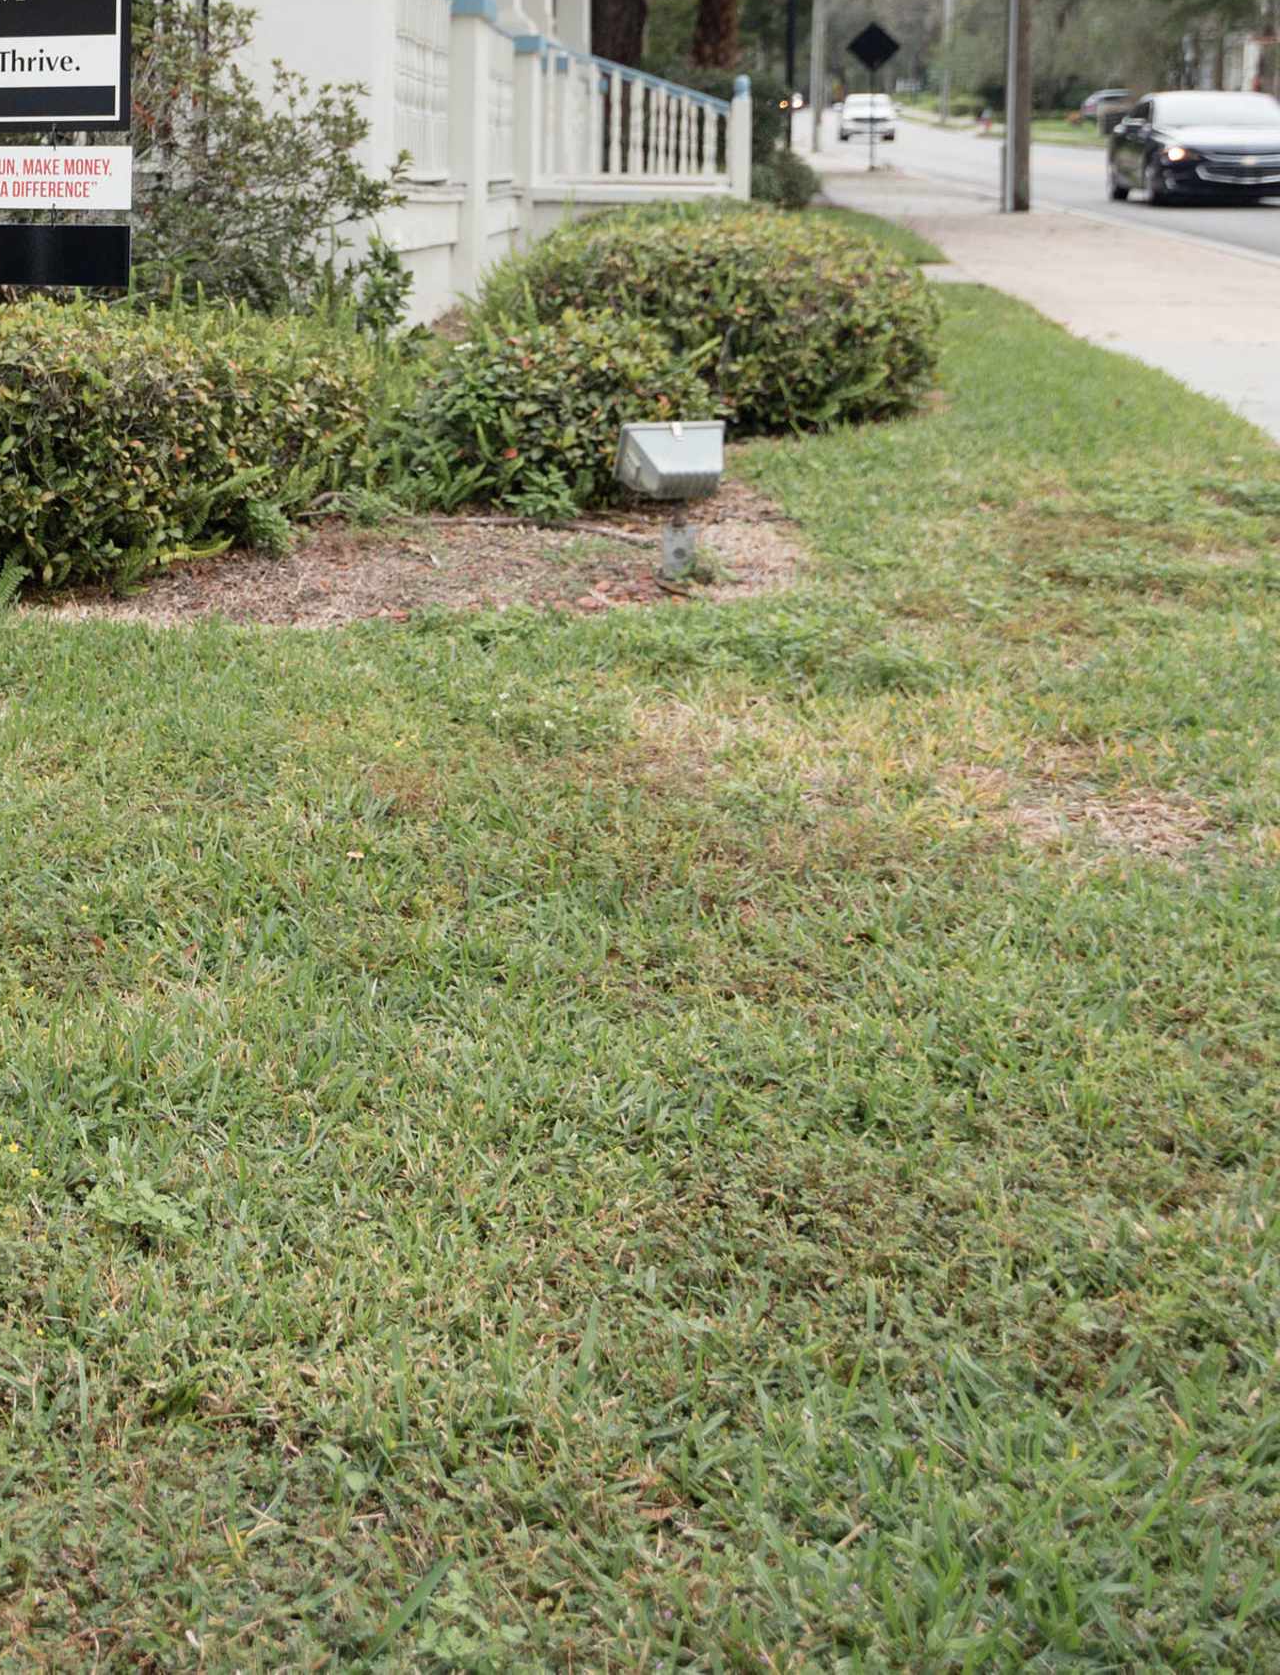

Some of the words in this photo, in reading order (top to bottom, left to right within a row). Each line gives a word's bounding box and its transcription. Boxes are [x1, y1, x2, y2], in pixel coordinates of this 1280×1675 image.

[22, 158, 60, 175] MAKE
[0, 181, 10, 197] A
[12, 180, 98, 198] DIFFERENCE”
